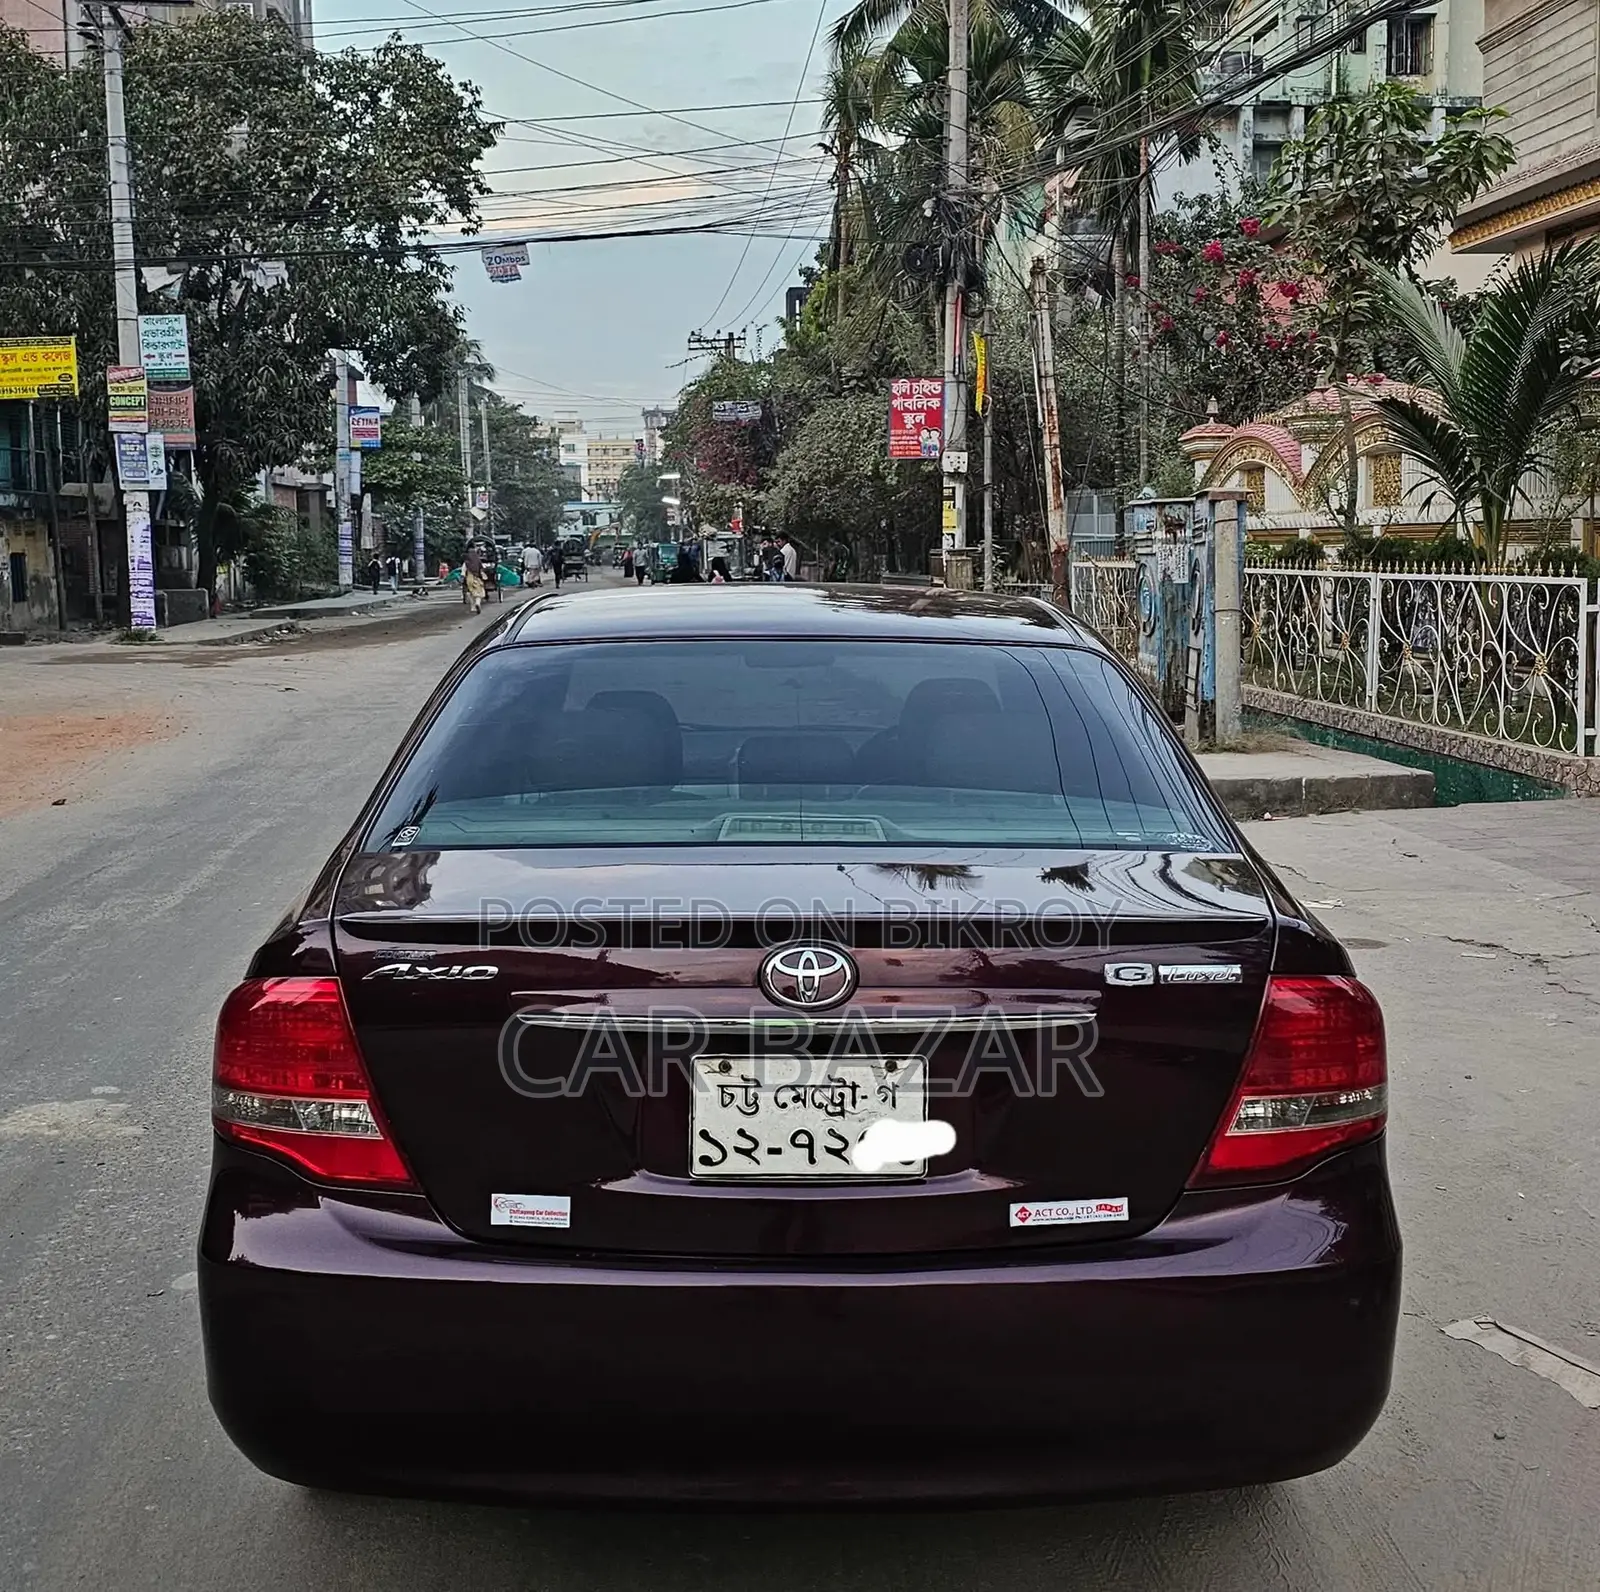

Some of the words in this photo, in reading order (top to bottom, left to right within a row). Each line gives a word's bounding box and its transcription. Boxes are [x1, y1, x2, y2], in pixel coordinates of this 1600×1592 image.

[486, 255, 526, 266] 20Mbps
[143, 316, 181, 326] বাংলাদেশ
[41, 350, 71, 362] কলেজ
[891, 378, 910, 396] হলি
[109, 396, 145, 407] CONCEPT
[892, 395, 942, 411] পাবলিক
[902, 412, 926, 430] স্কুল
[1113, 966, 1147, 982] G
[717, 1075, 761, 1116] চট্ট
[698, 1127, 915, 1167] ১২-৭২
[1034, 1208, 1053, 1217] ACT
[1075, 1206, 1096, 1215] LTD.
[1097, 1204, 1124, 1212] JAPAN
